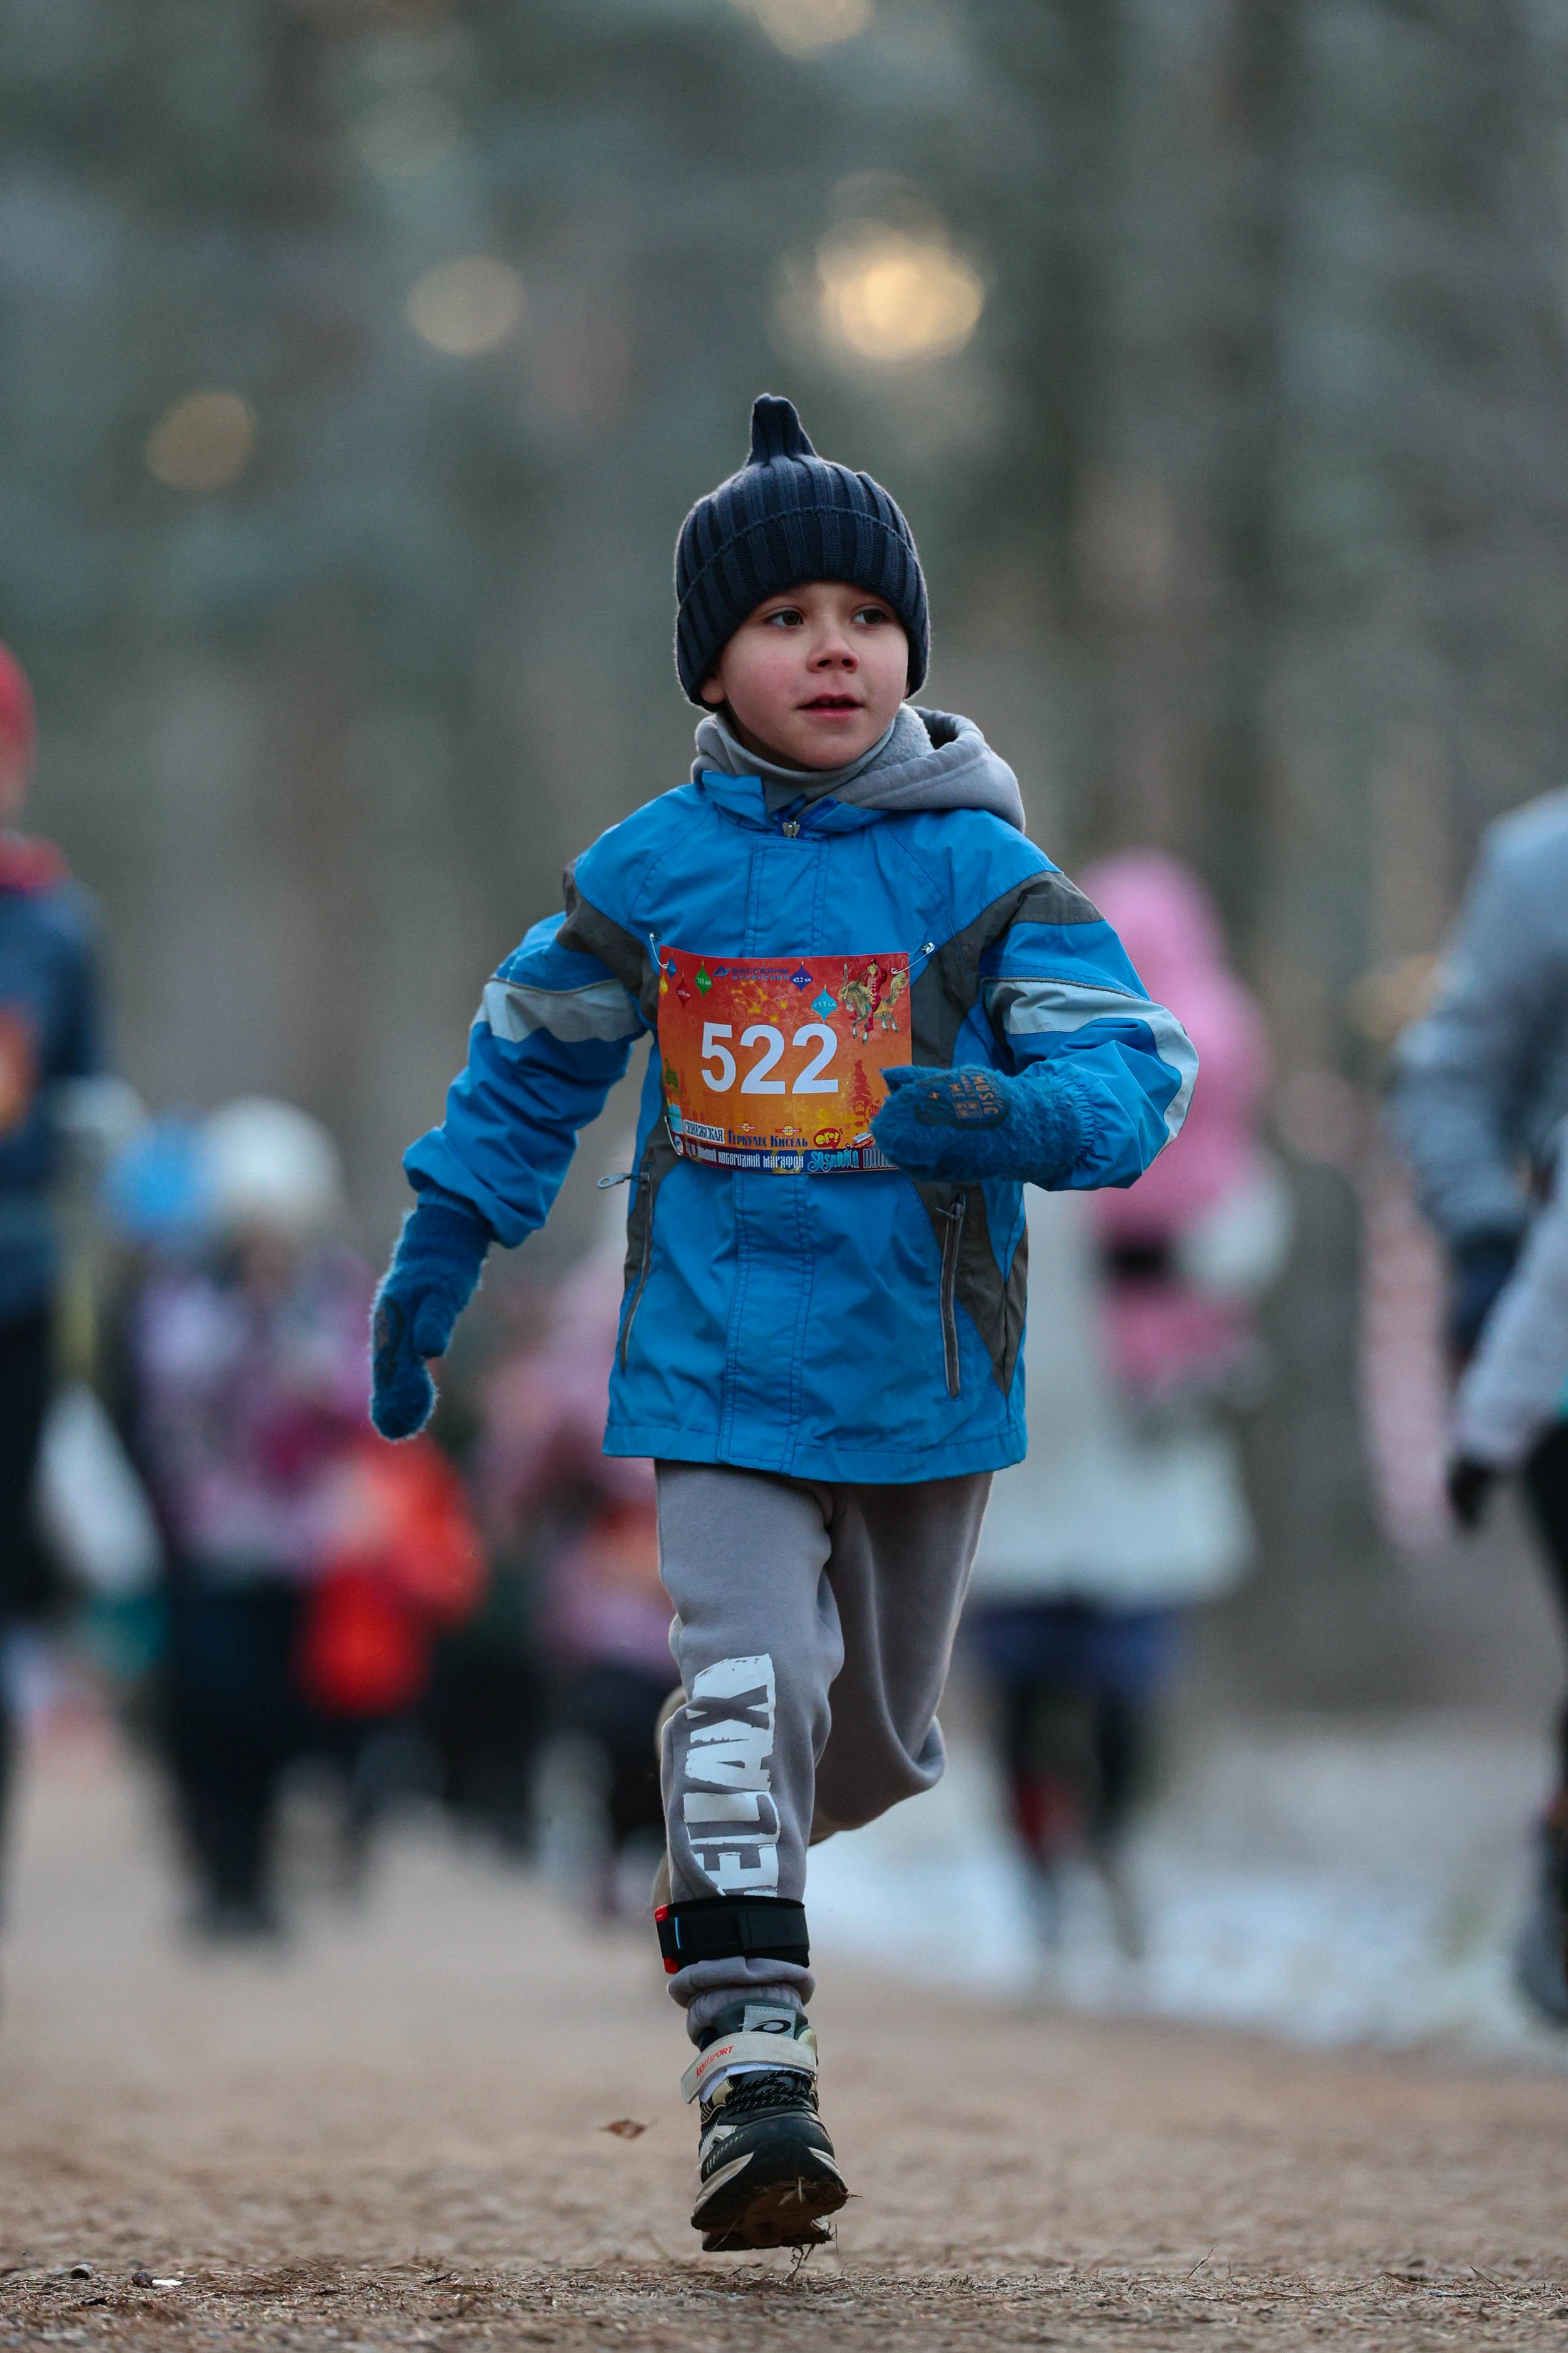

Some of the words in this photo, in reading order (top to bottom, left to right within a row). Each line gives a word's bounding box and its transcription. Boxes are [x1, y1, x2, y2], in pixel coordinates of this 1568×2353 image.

[701, 1021, 839, 1095] 522
[763, 1155, 804, 1169] МАРАФОН
[683, 1653, 781, 1897] ELAX
